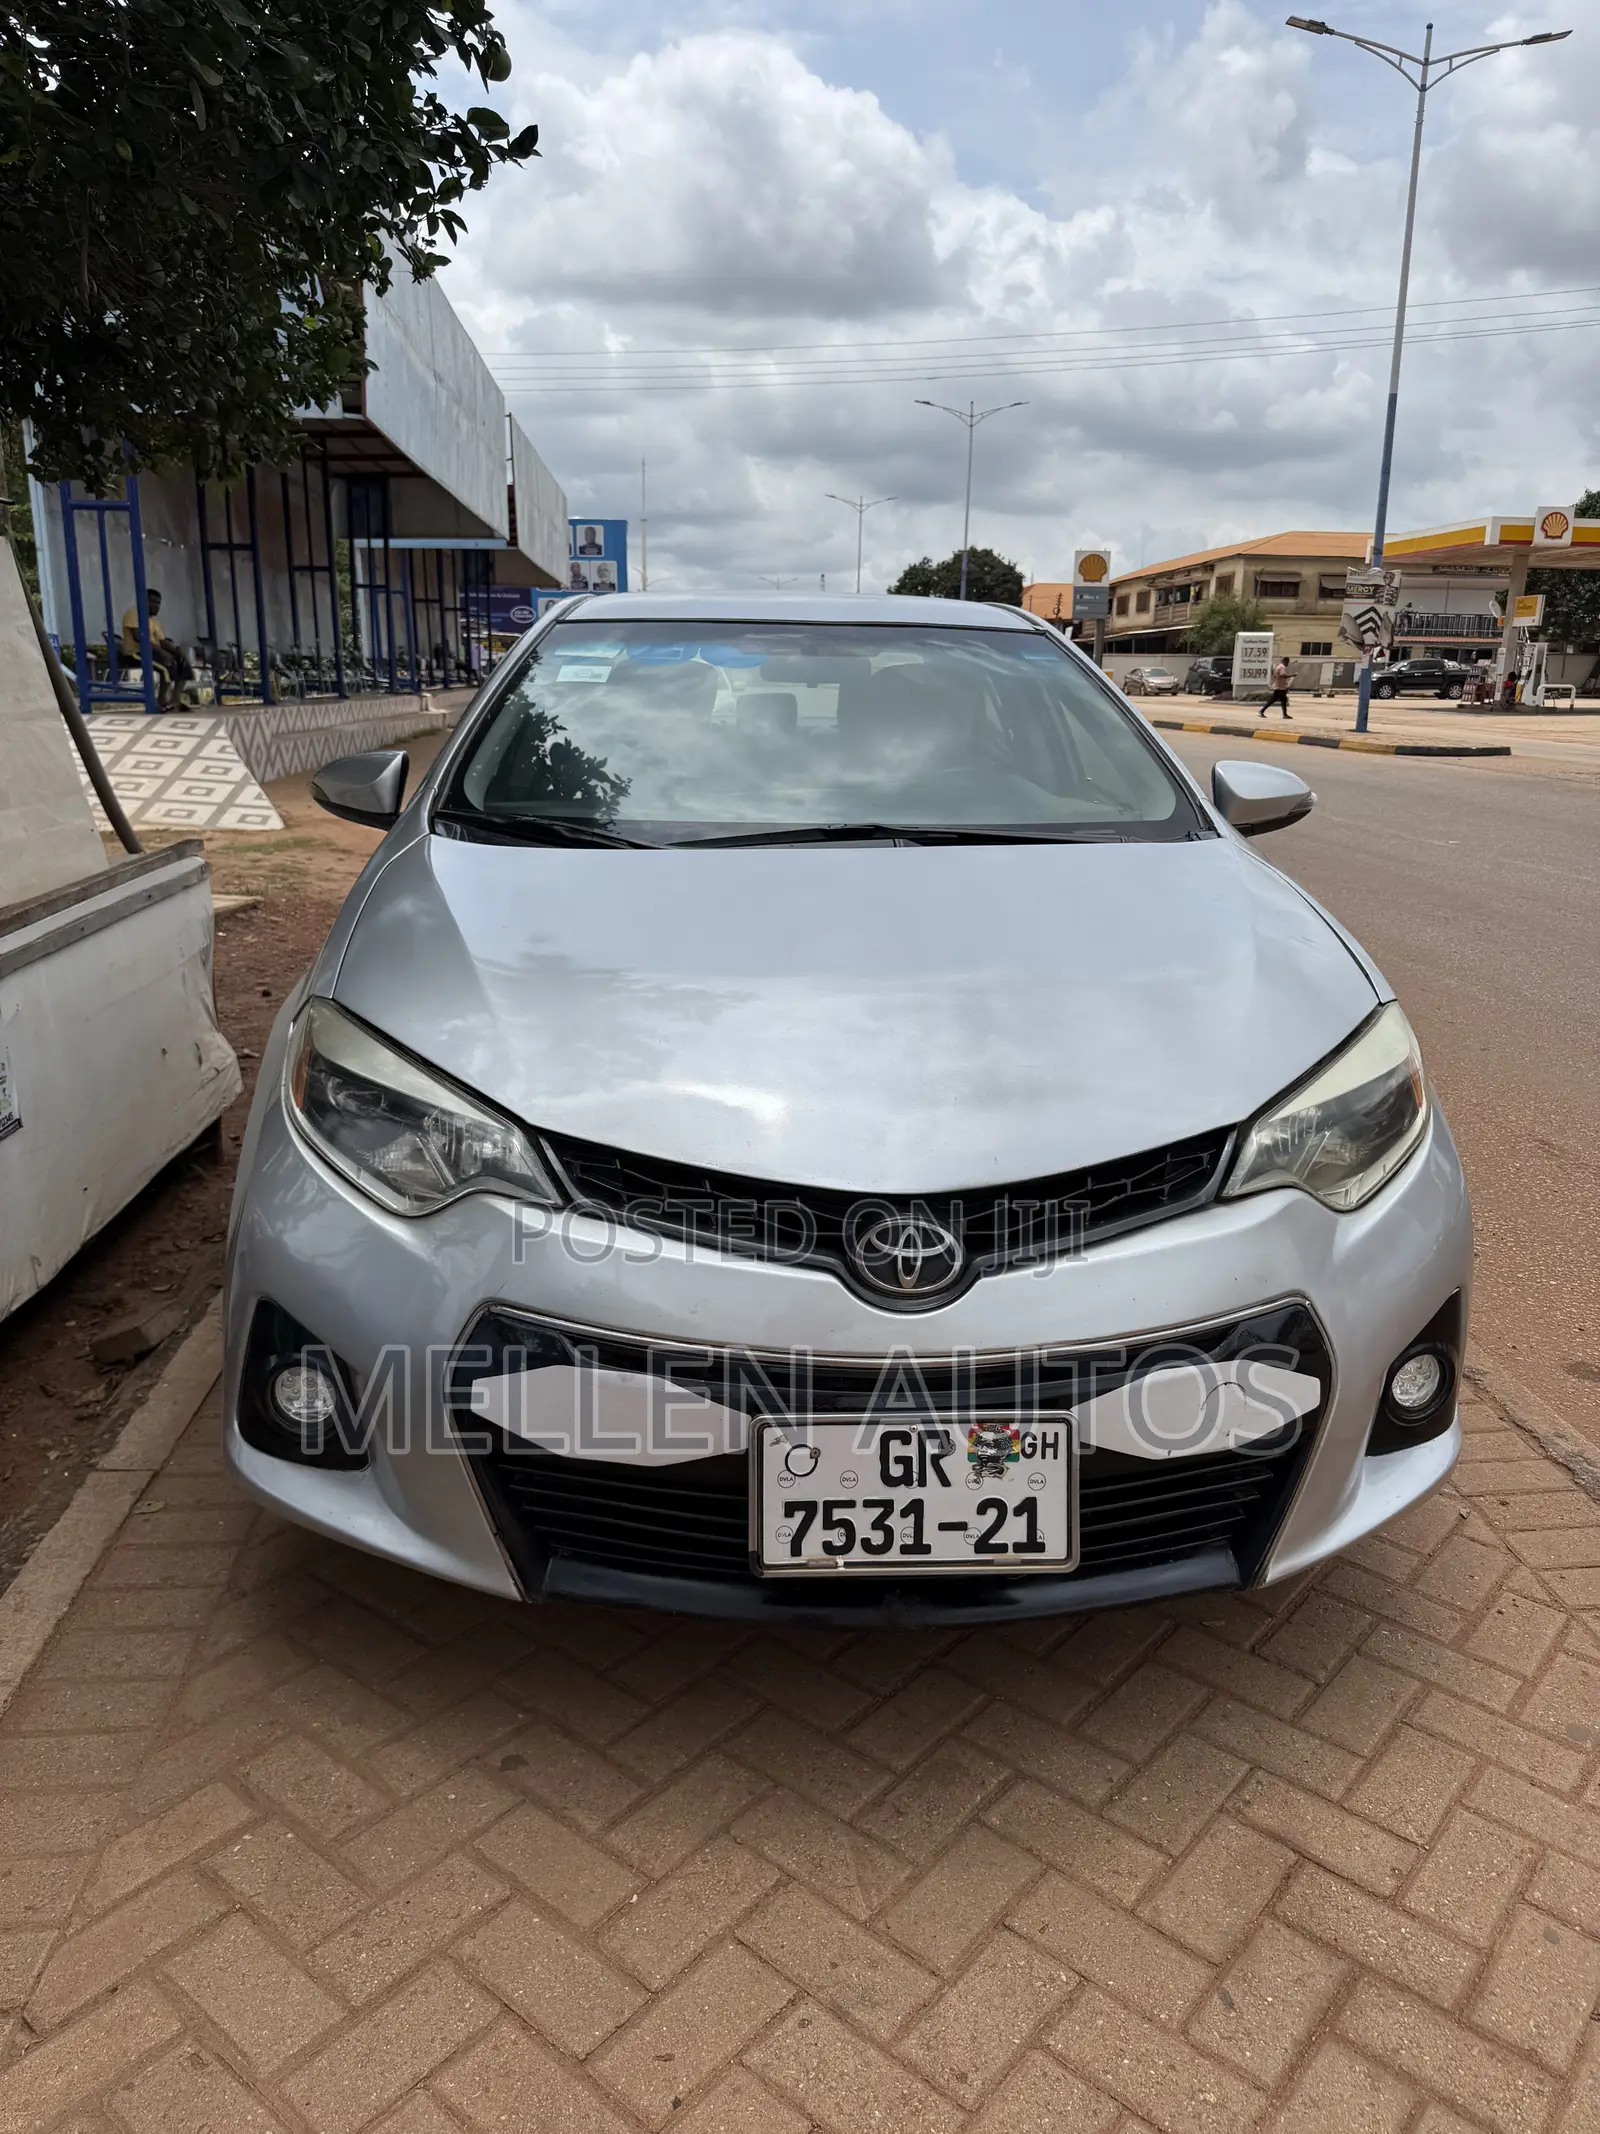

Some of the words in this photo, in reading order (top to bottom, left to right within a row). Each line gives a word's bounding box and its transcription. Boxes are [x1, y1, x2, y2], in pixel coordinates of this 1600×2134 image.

[1346, 586, 1375, 595] MERCY
[1244, 647, 1267, 657] 17.59
[879, 1430, 952, 1488] GR
[1020, 1431, 1059, 1460] GH
[783, 1497, 1046, 1557] 7531-21
